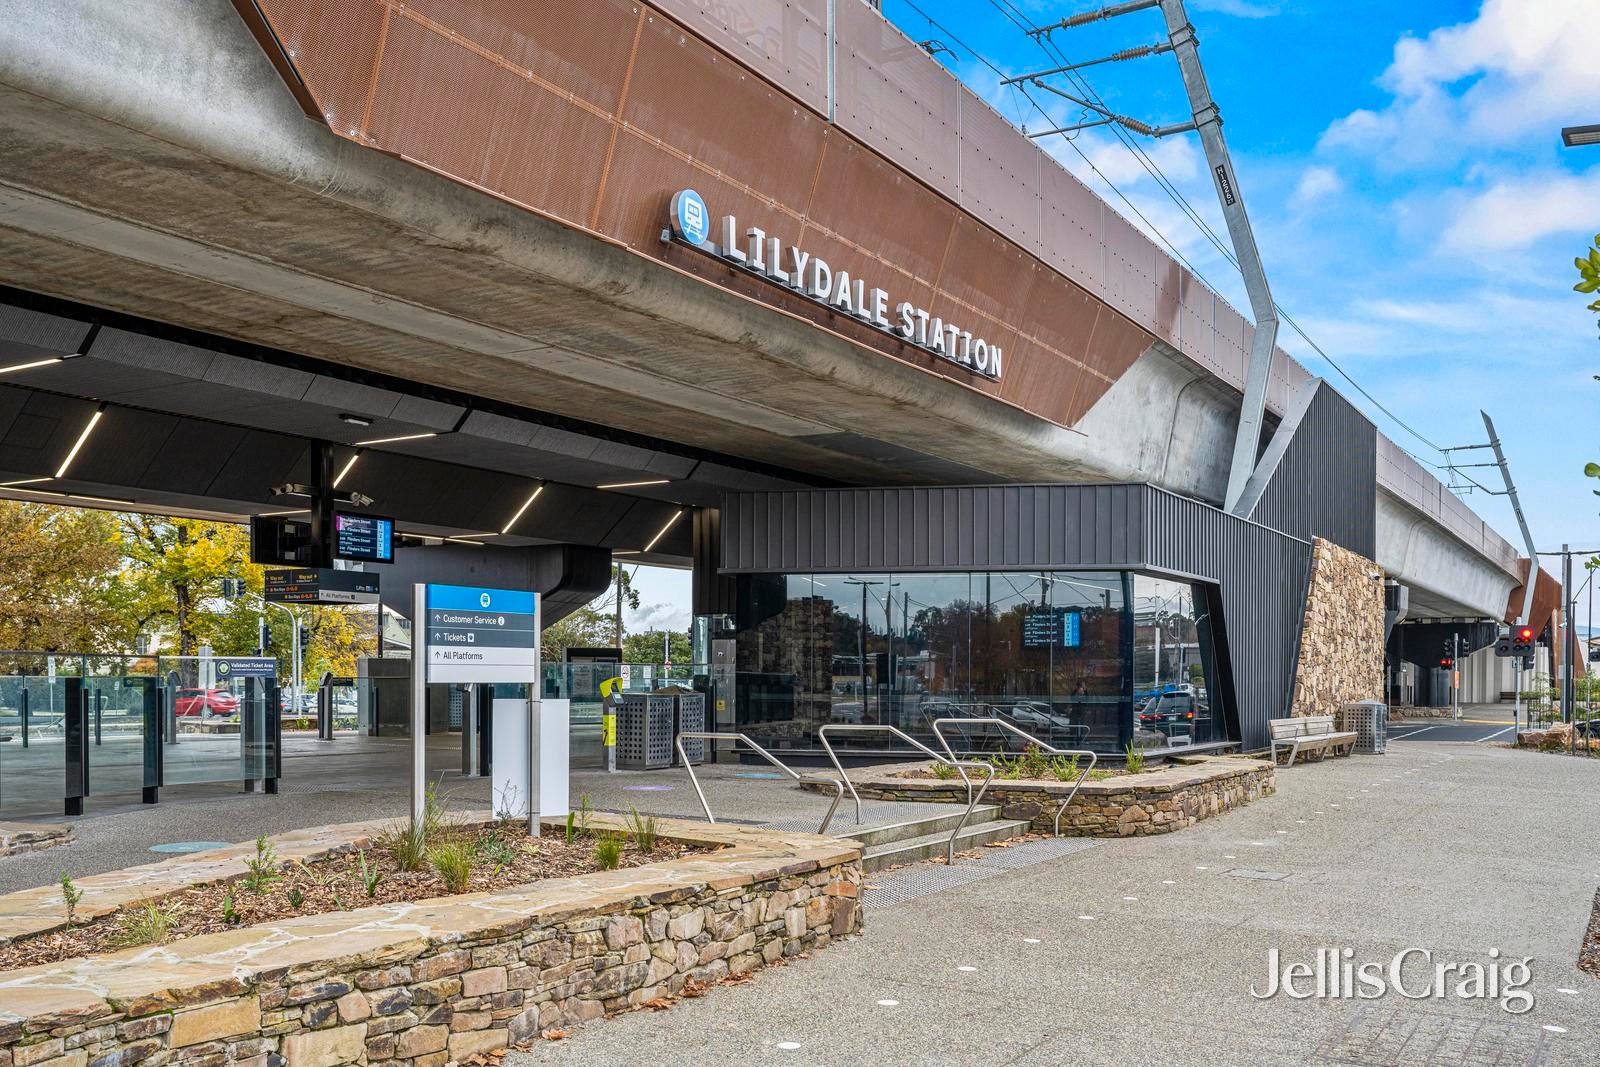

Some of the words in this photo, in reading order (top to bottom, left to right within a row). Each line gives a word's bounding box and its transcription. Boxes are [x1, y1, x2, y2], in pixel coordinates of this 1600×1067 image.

[722, 214, 889, 328] LILYDALE
[896, 302, 1002, 379] STATION
[443, 614, 473, 624] Customer
[474, 616, 497, 625] Service
[443, 632, 466, 642] Tickets
[443, 651, 452, 660] All
[453, 651, 483, 660] Platforms
